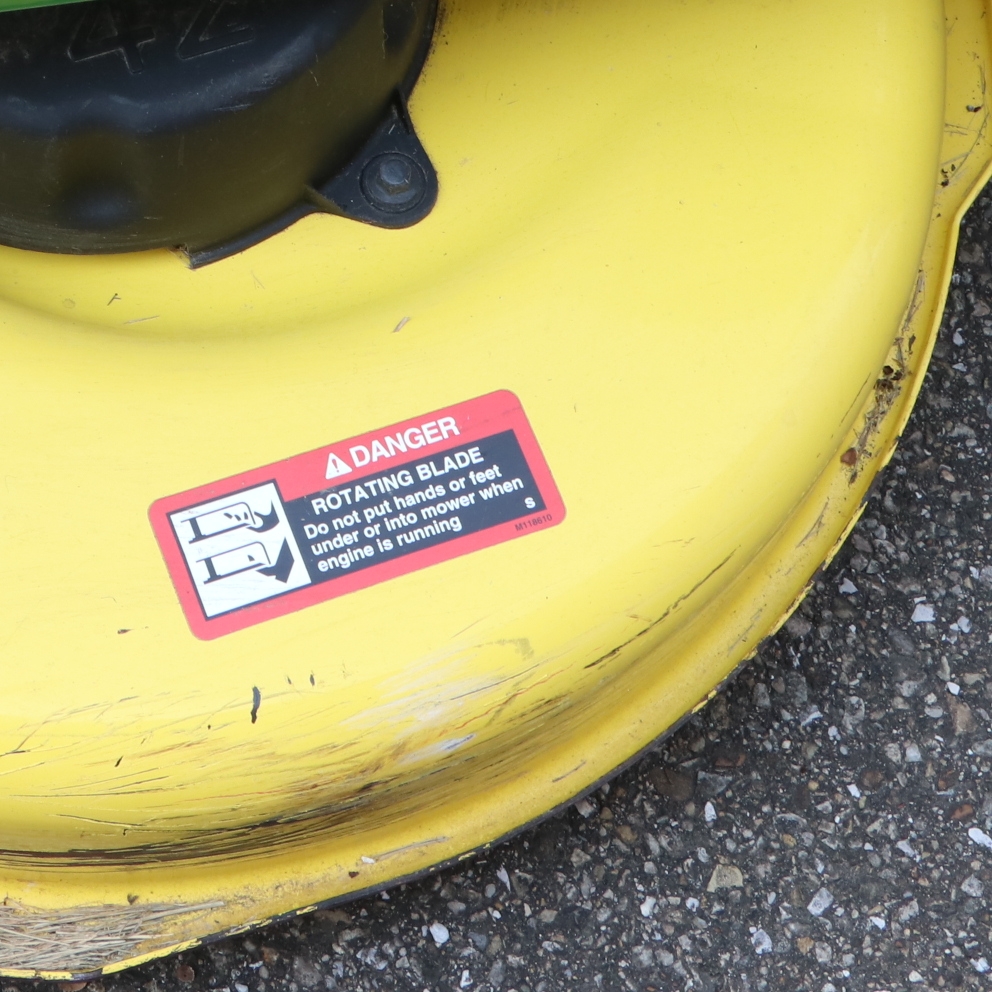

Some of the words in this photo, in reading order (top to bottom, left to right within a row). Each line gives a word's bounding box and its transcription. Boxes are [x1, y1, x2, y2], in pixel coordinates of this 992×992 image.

[349, 416, 460, 468] DANGER
[303, 523, 329, 540] Do
[332, 510, 361, 530] not
[363, 500, 392, 523] put
[393, 484, 446, 510] hands
[449, 477, 466, 492] or
[469, 464, 502, 485] feet
[311, 470, 414, 515] ROTATING
[415, 446, 484, 481] BLADE
[311, 533, 359, 556] under
[363, 523, 381, 538] or
[384, 512, 418, 532] into
[420, 492, 476, 520] mower
[478, 477, 524, 501] when
[317, 544, 375, 573] engine
[376, 538, 394, 553] is
[396, 516, 463, 547] running
[515, 514, 553, 531] M118610
